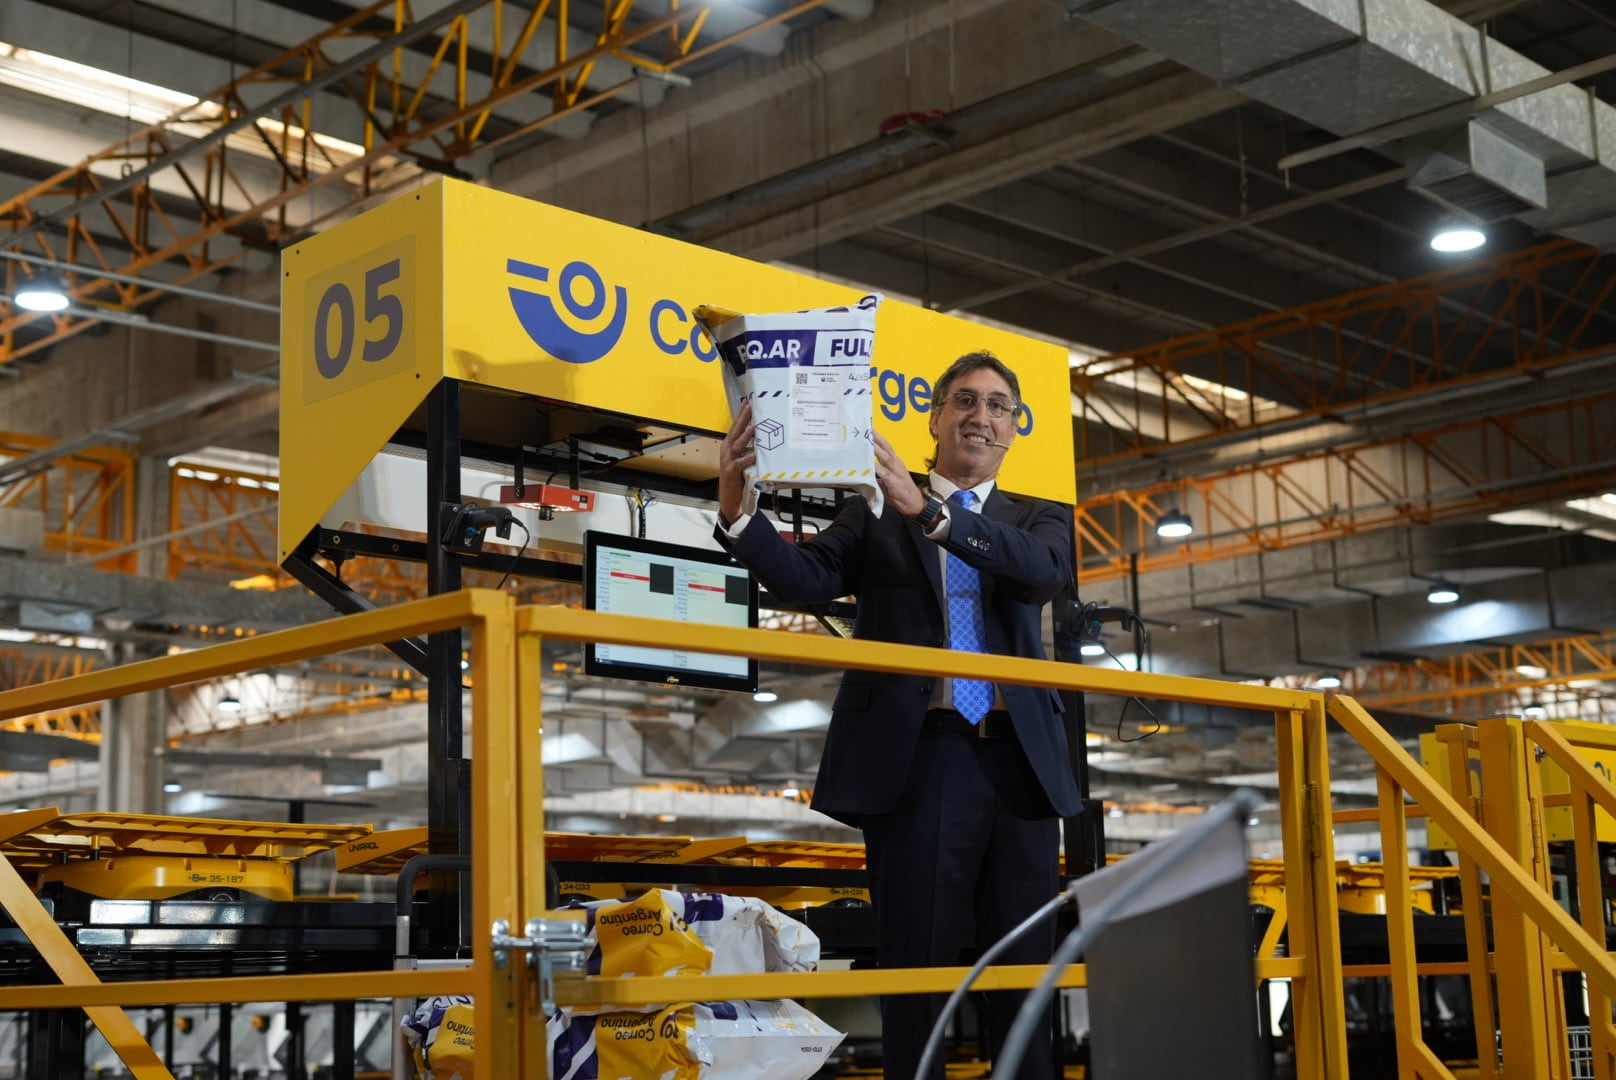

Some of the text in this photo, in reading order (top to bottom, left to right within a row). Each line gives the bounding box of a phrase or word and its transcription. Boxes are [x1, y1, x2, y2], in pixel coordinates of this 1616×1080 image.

[313, 258, 404, 380] 05
[830, 337, 874, 358] FUL
[209, 874, 244, 884] 35-187
[600, 908, 662, 926] Argentino
[622, 923, 664, 937] Correo
[615, 1028, 655, 1042] Correo
